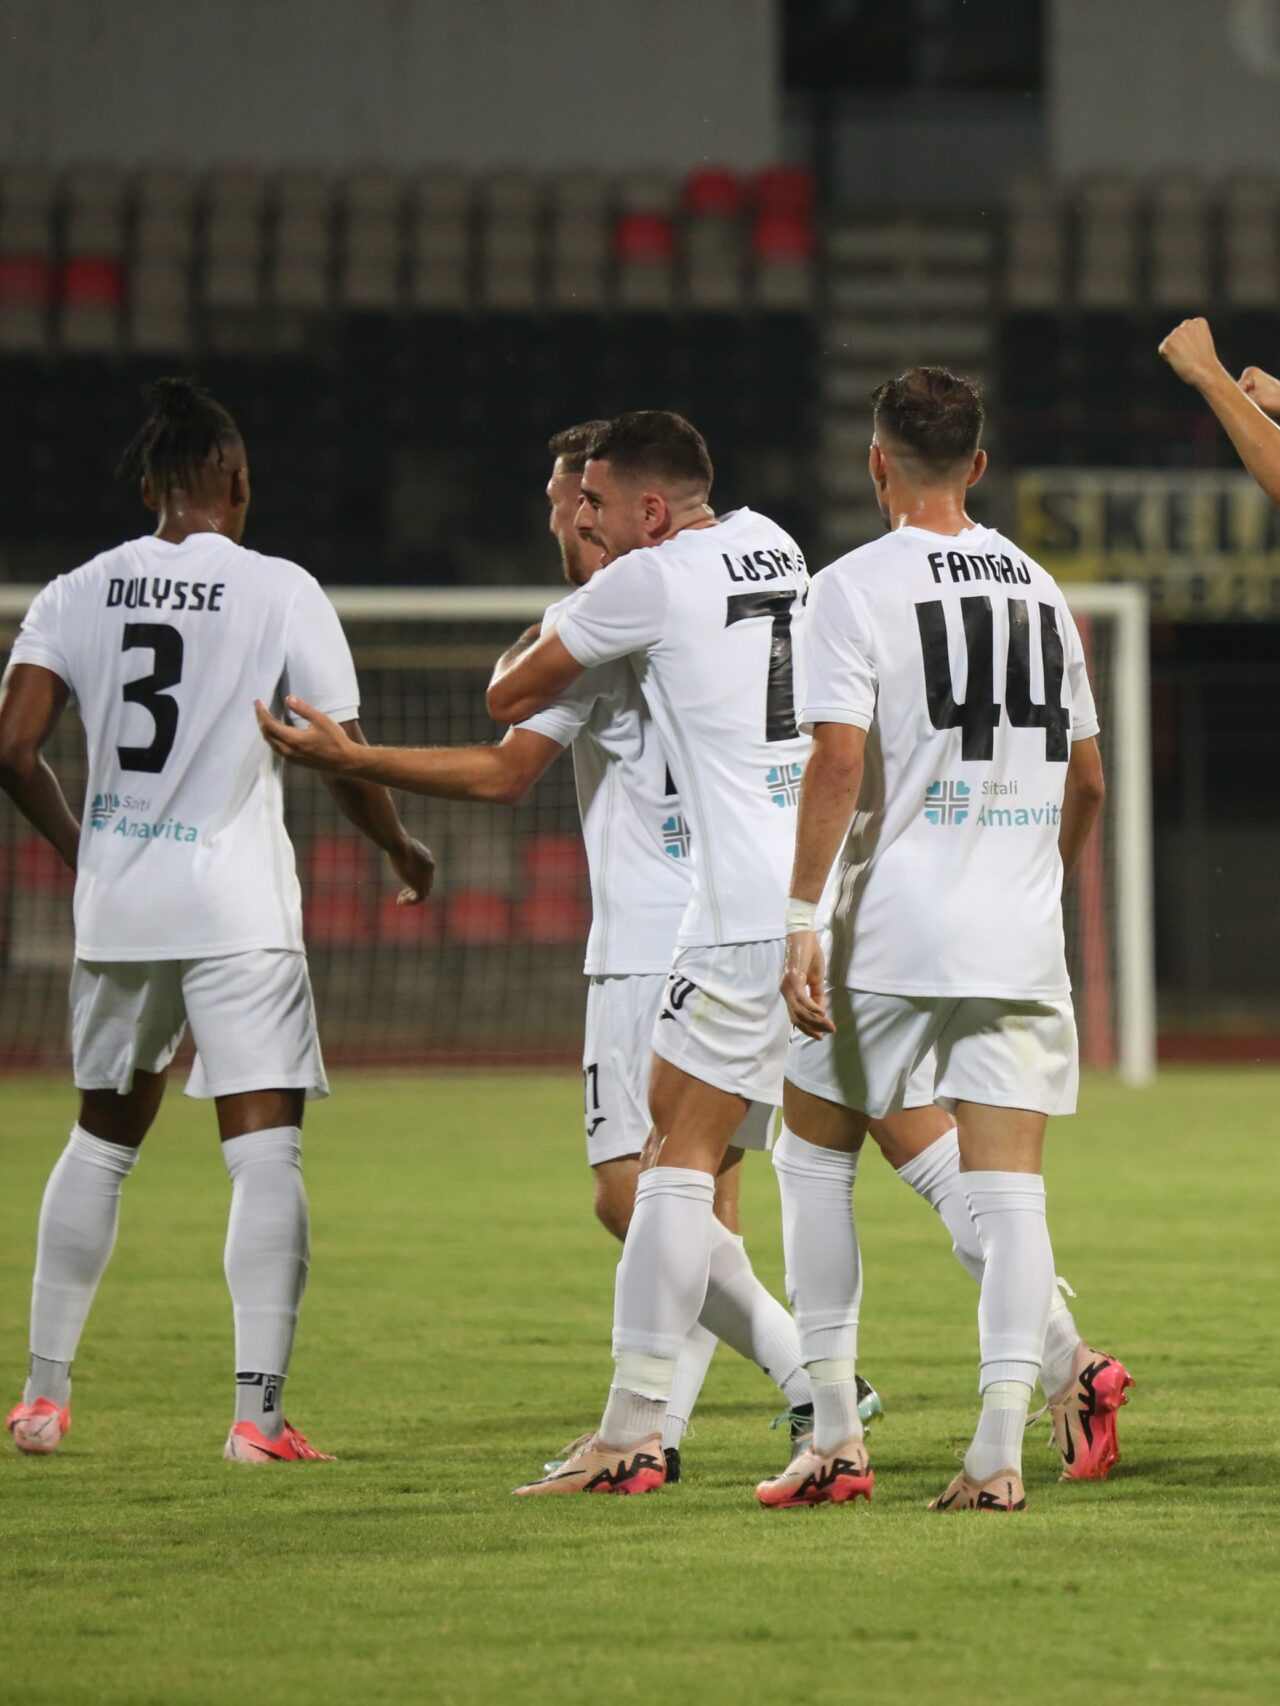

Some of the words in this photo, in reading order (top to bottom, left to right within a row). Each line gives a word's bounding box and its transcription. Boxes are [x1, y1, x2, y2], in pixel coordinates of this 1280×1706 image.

[117, 623, 184, 774] 3
[725, 588, 809, 743] 7
[914, 596, 1071, 763] 44
